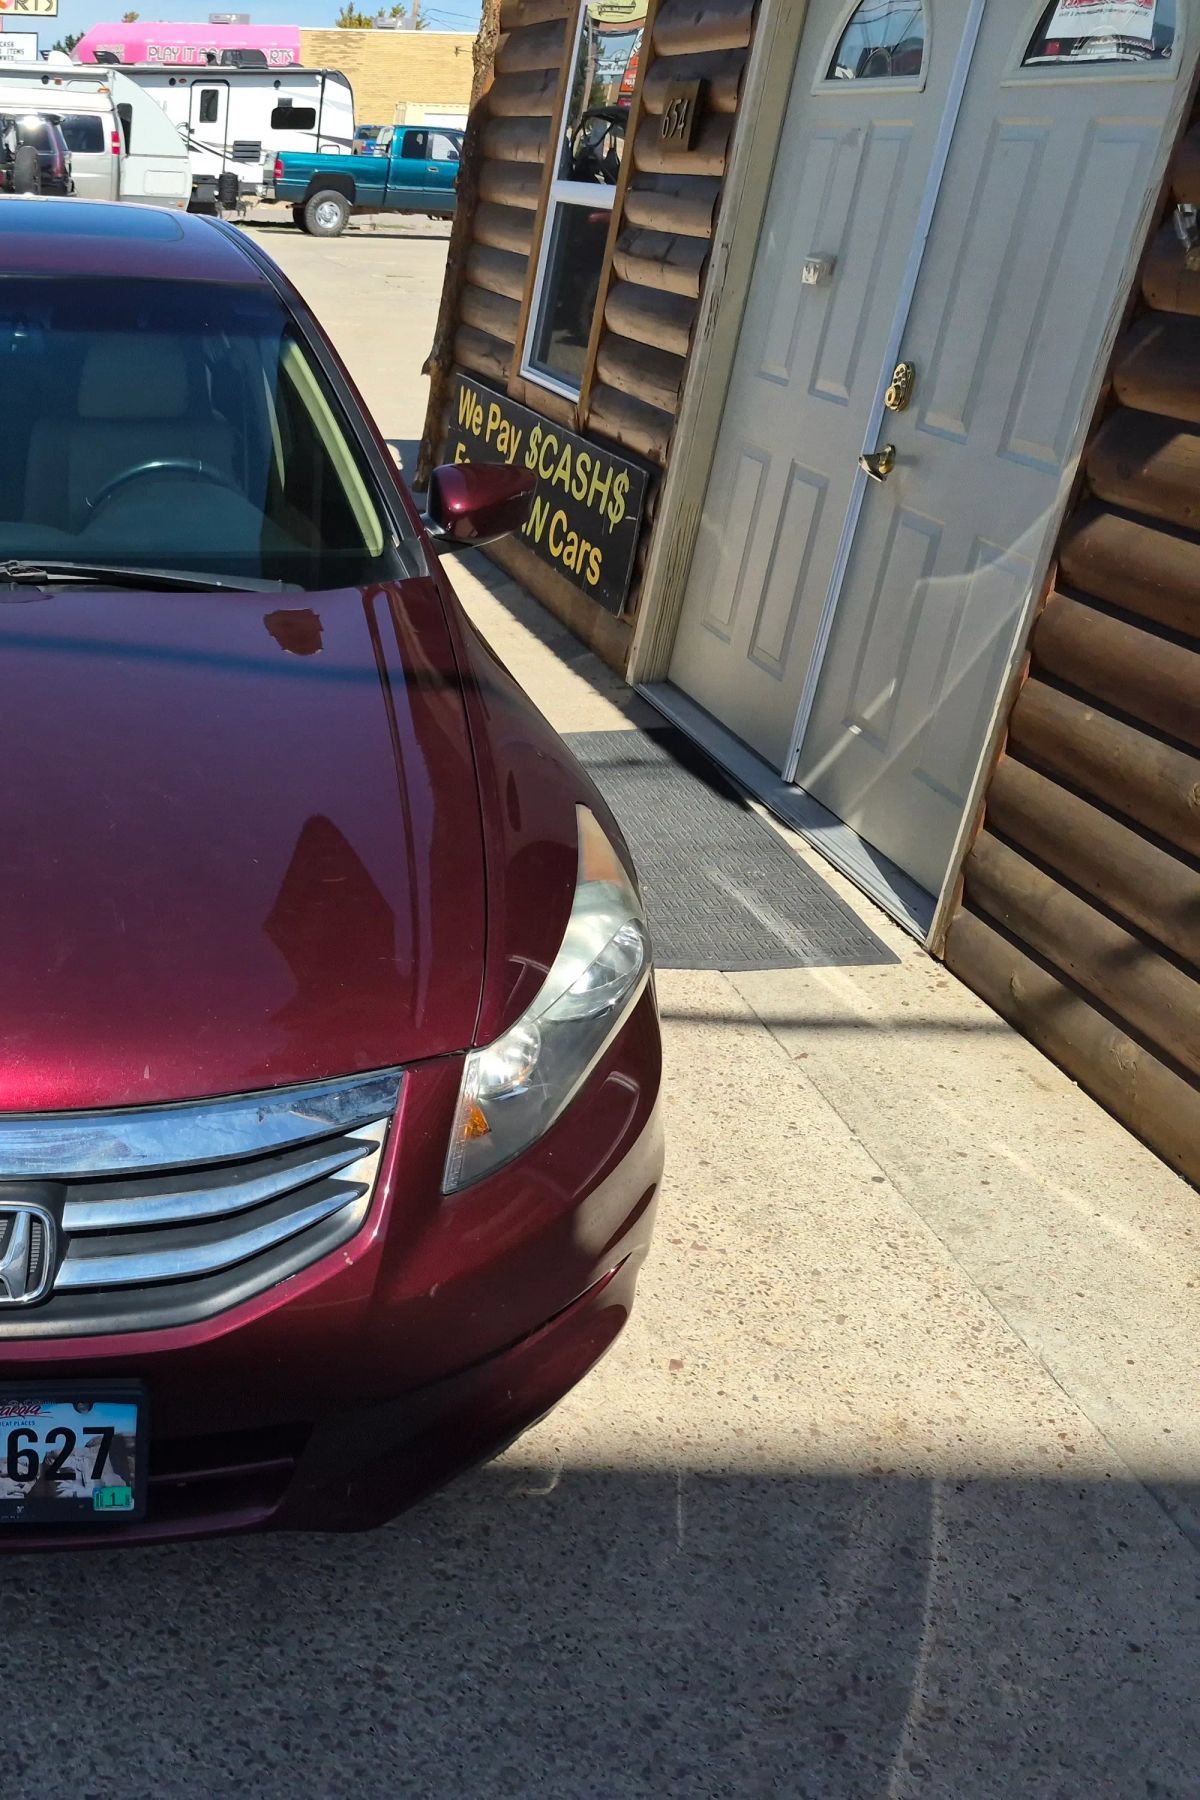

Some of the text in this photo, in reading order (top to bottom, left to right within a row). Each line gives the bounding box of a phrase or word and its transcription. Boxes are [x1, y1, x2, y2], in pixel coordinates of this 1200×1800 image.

[149, 46, 180, 62] PLAY
[181, 46, 195, 62] IT
[661, 98, 689, 139] 654
[458, 385, 630, 534] We Pay $CASH$
[549, 509, 603, 586] Cars
[6, 1426, 115, 1483] 627
